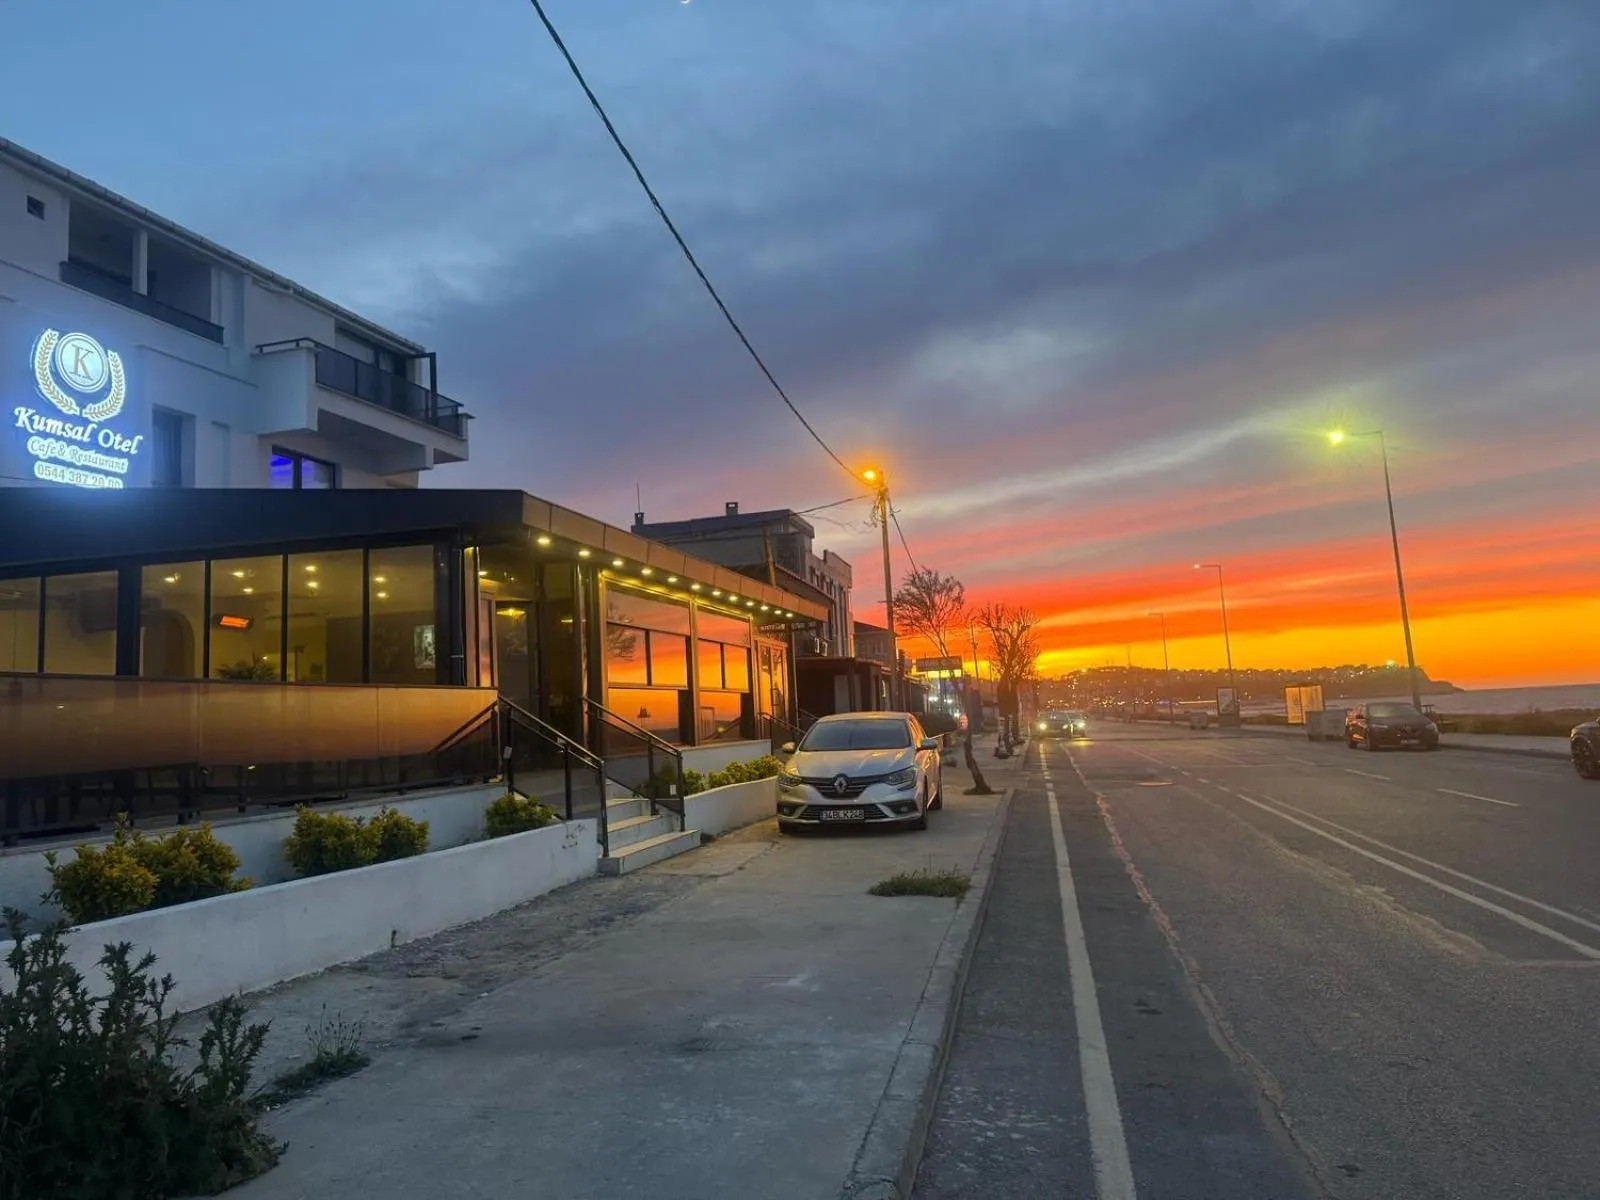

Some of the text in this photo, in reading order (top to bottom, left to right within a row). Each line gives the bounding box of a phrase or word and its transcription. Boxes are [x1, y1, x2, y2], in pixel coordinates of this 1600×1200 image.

[69, 343, 94, 381] K
[14, 406, 144, 455] Kumsal Otel
